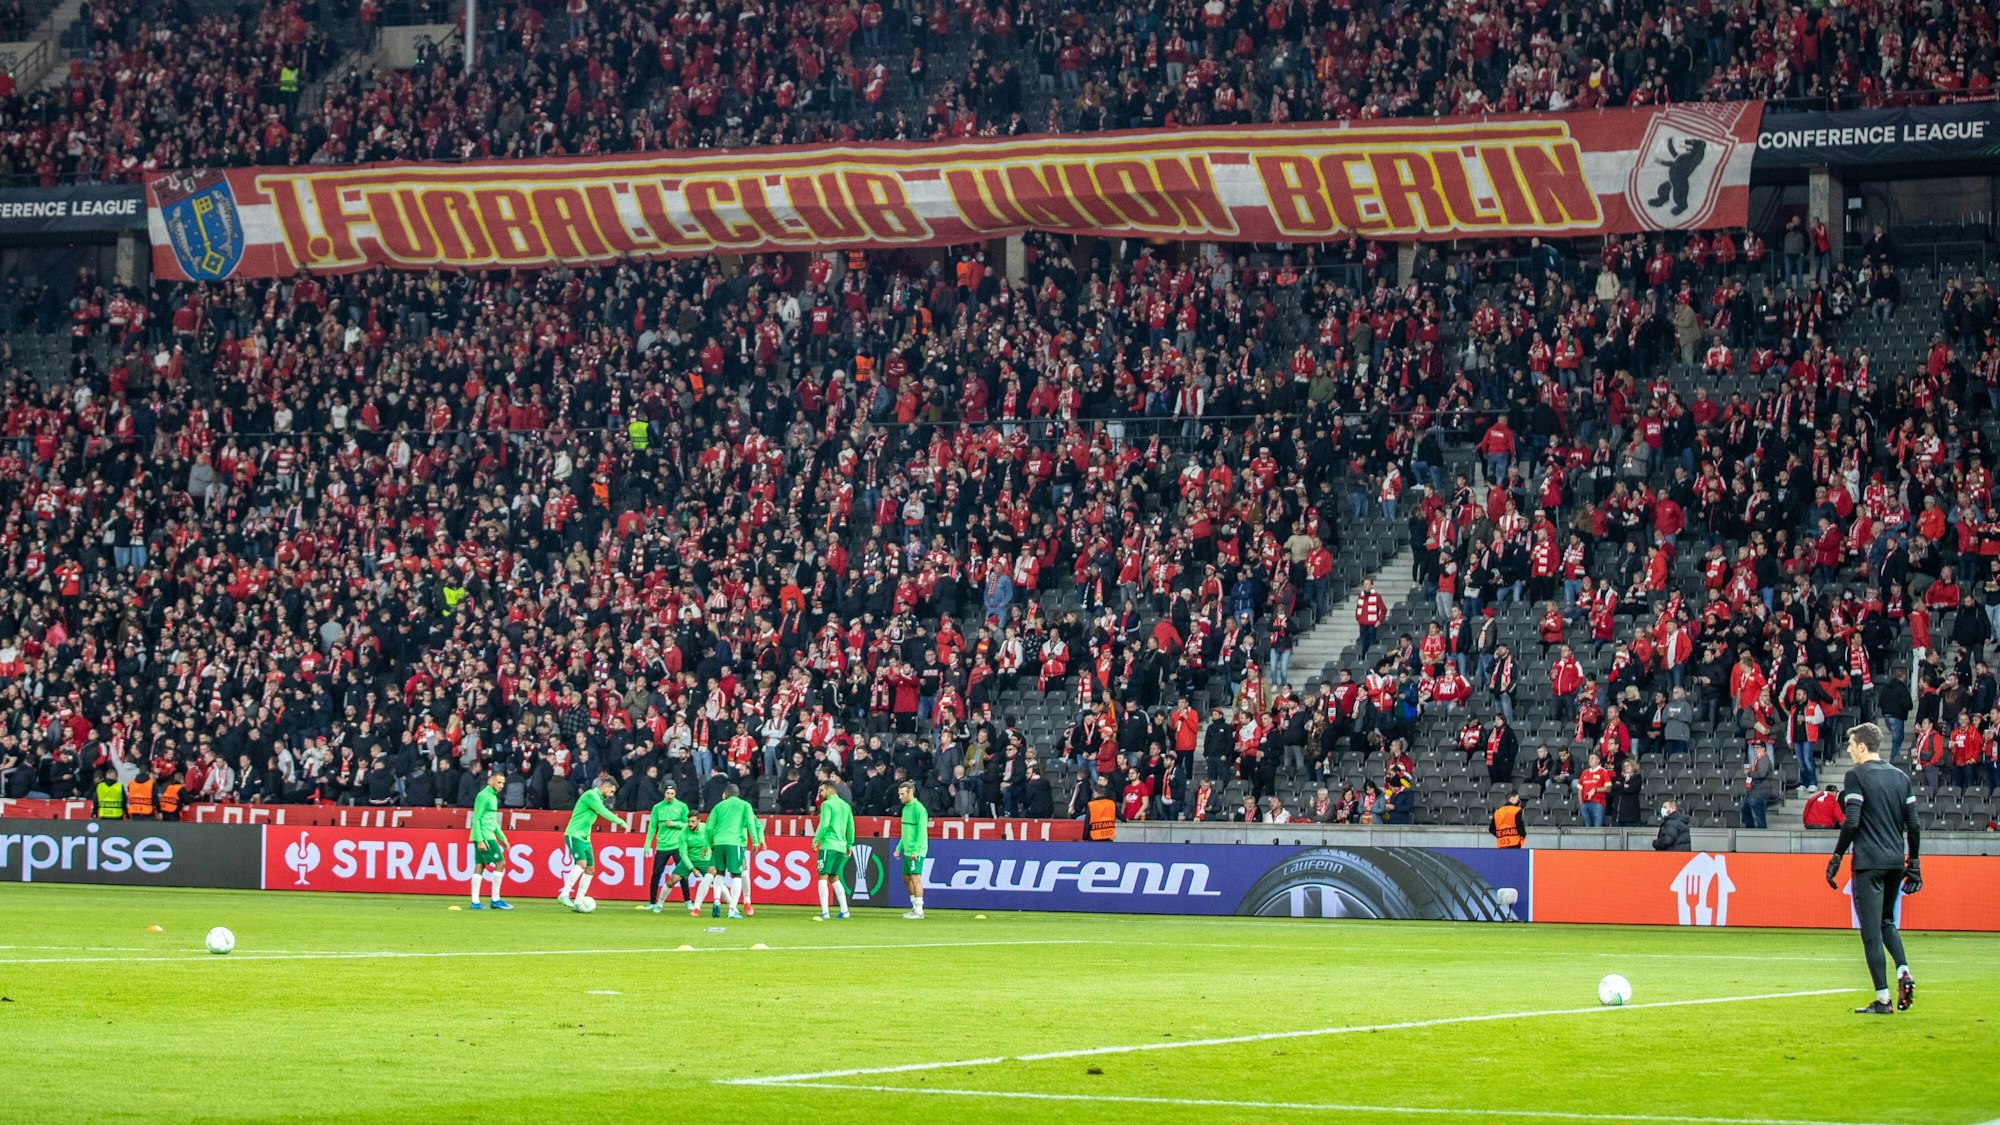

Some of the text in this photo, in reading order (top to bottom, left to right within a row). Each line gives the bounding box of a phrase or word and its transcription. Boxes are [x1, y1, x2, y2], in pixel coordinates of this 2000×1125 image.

[1758, 121, 1984, 149] CONFERENCE LEAGUE
[0, 200, 137, 217] ERENCE LEAGUE
[941, 151, 1240, 234] UNION
[1251, 138, 1604, 236] BERLIN
[0, 822, 173, 882] rprise
[598, 846, 811, 890] STSS
